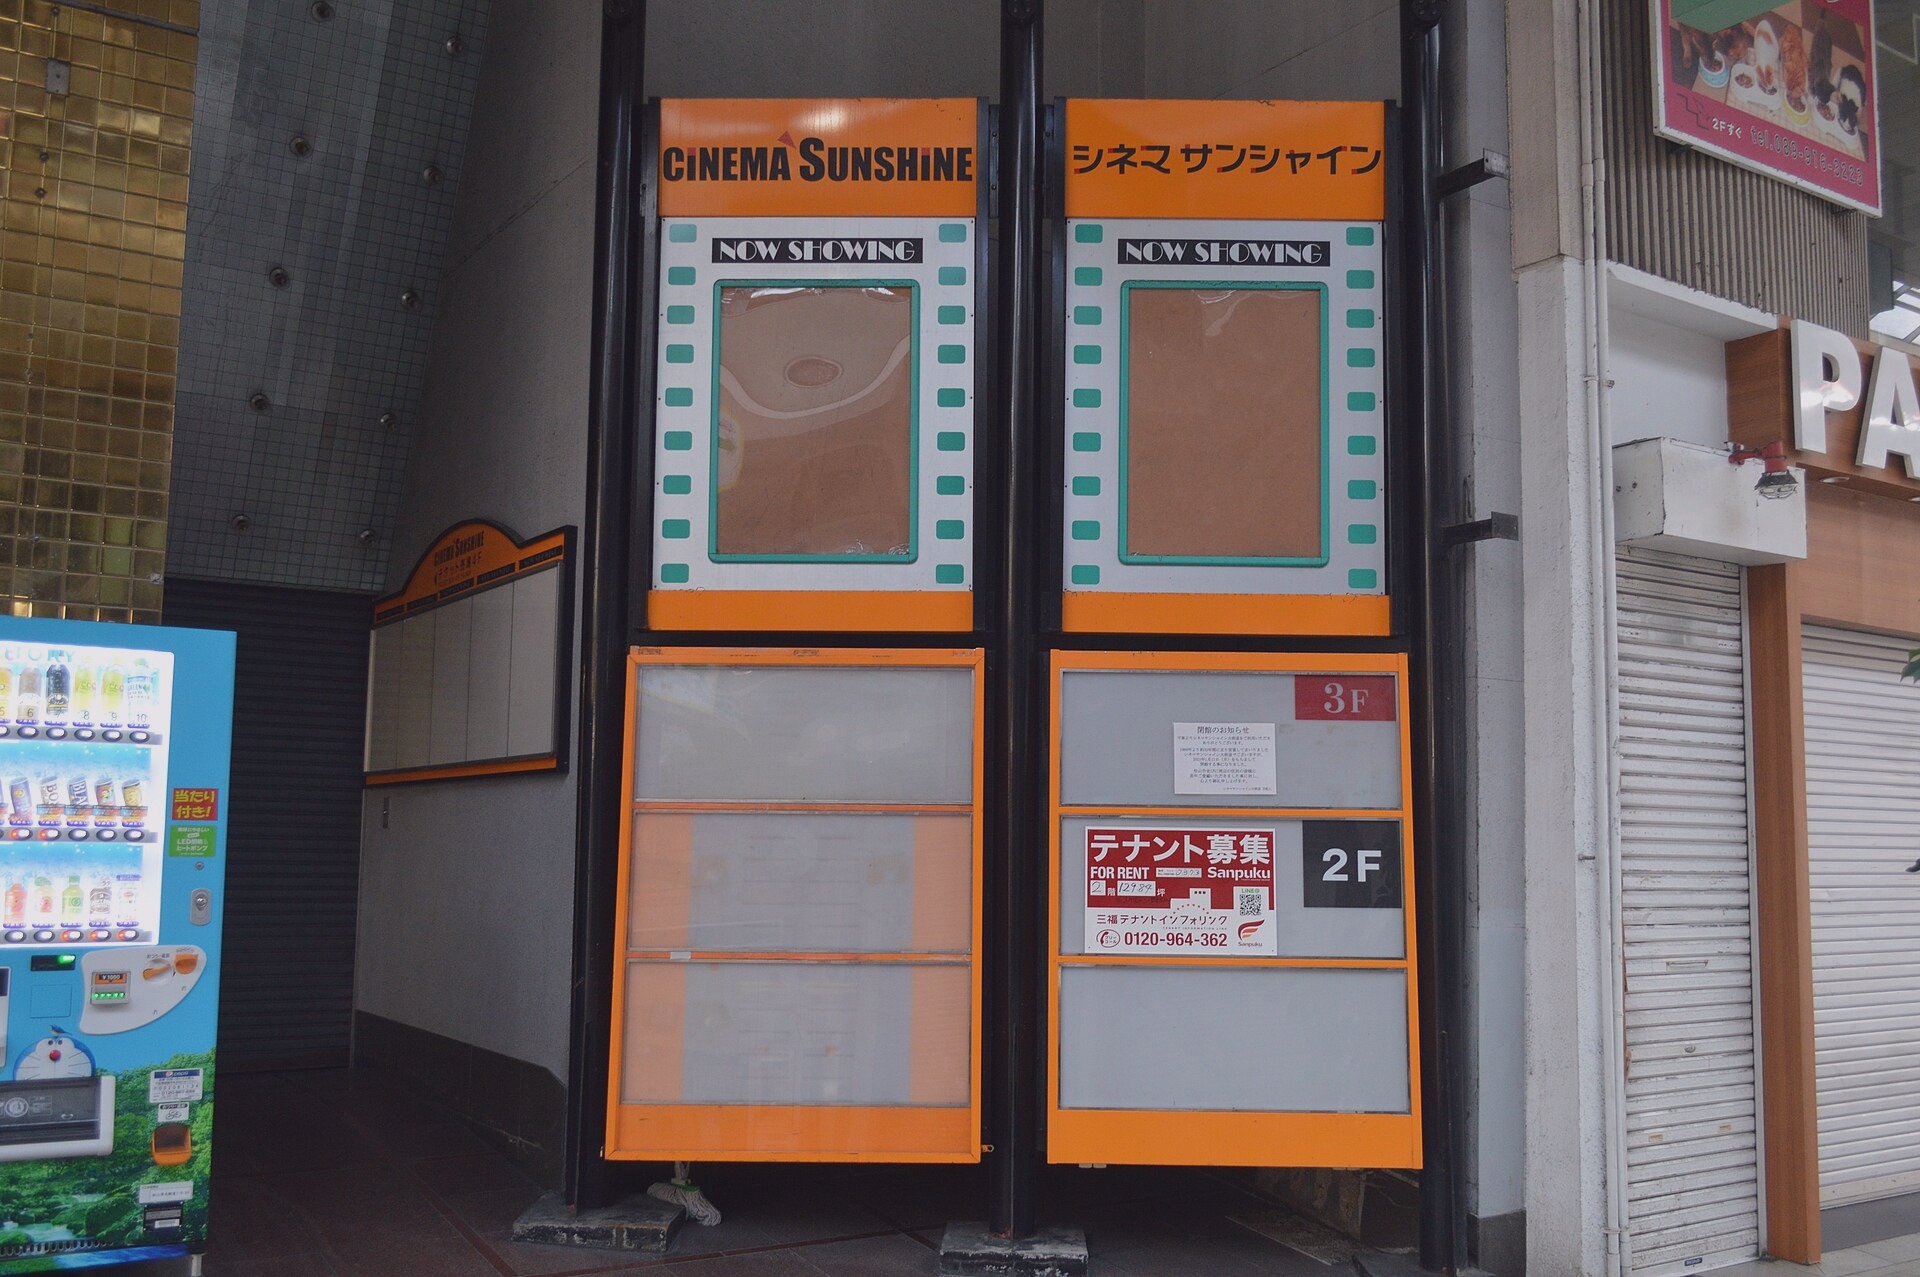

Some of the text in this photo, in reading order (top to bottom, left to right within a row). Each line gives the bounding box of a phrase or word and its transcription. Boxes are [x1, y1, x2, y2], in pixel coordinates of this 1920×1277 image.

[720, 241, 915, 261] NOW SHOWING
[1126, 242, 1322, 264] NOW SHOWING
[1324, 682, 1369, 713] 3F
[27, 708, 34, 718] 6
[83, 710, 90, 720] 8
[111, 712, 118, 721] 9
[137, 714, 147, 723] 10
[175, 789, 215, 803] 当たり
[1091, 833, 1270, 864] テナント募集
[1322, 848, 1382, 882] 2F
[1090, 866, 1114, 879] FOR
[1117, 867, 1149, 880] RENT
[1207, 867, 1271, 881] Sanpuku
[1124, 932, 1228, 946] 0120-964-362
